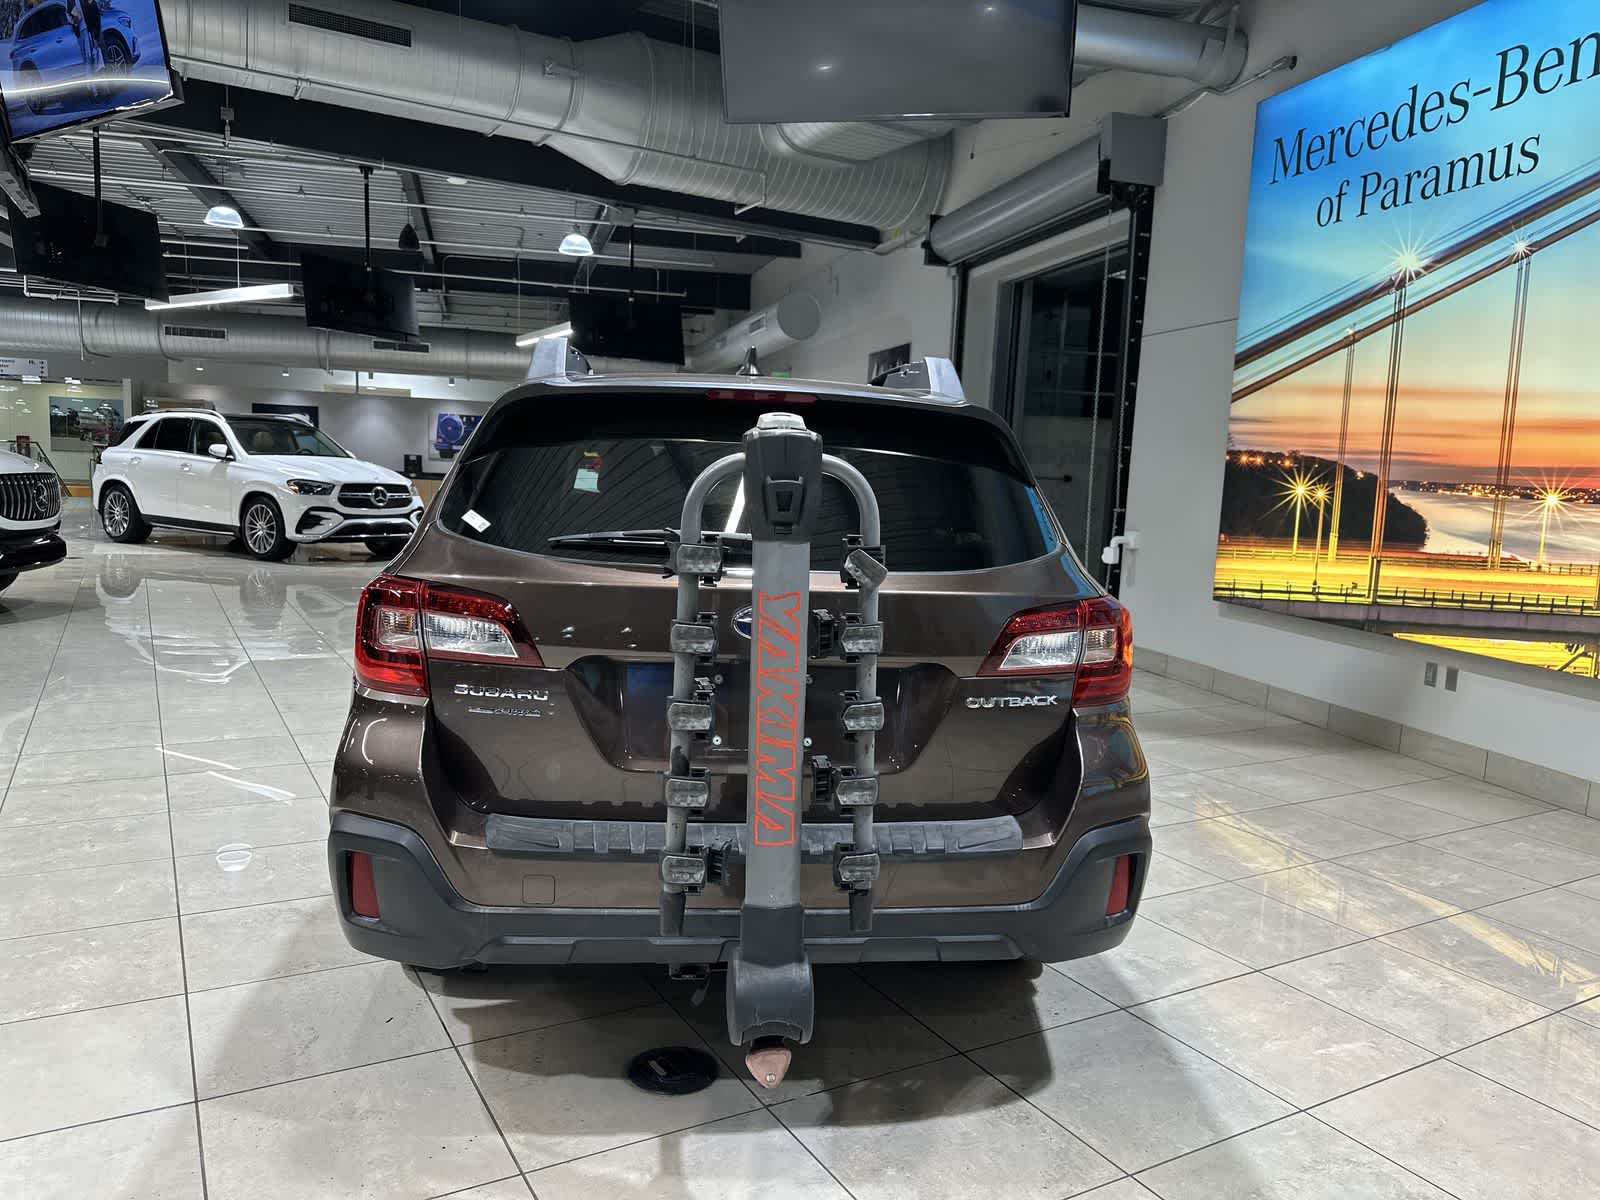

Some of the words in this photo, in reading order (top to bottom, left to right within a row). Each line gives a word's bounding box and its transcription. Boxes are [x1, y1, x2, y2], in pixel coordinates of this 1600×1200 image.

[1316, 179, 1349, 227] of
[1356, 134, 1541, 218] Paramus
[453, 684, 549, 701] SUBARU
[754, 590, 801, 847] YAKIMA
[965, 695, 1058, 709] OUTBACK
